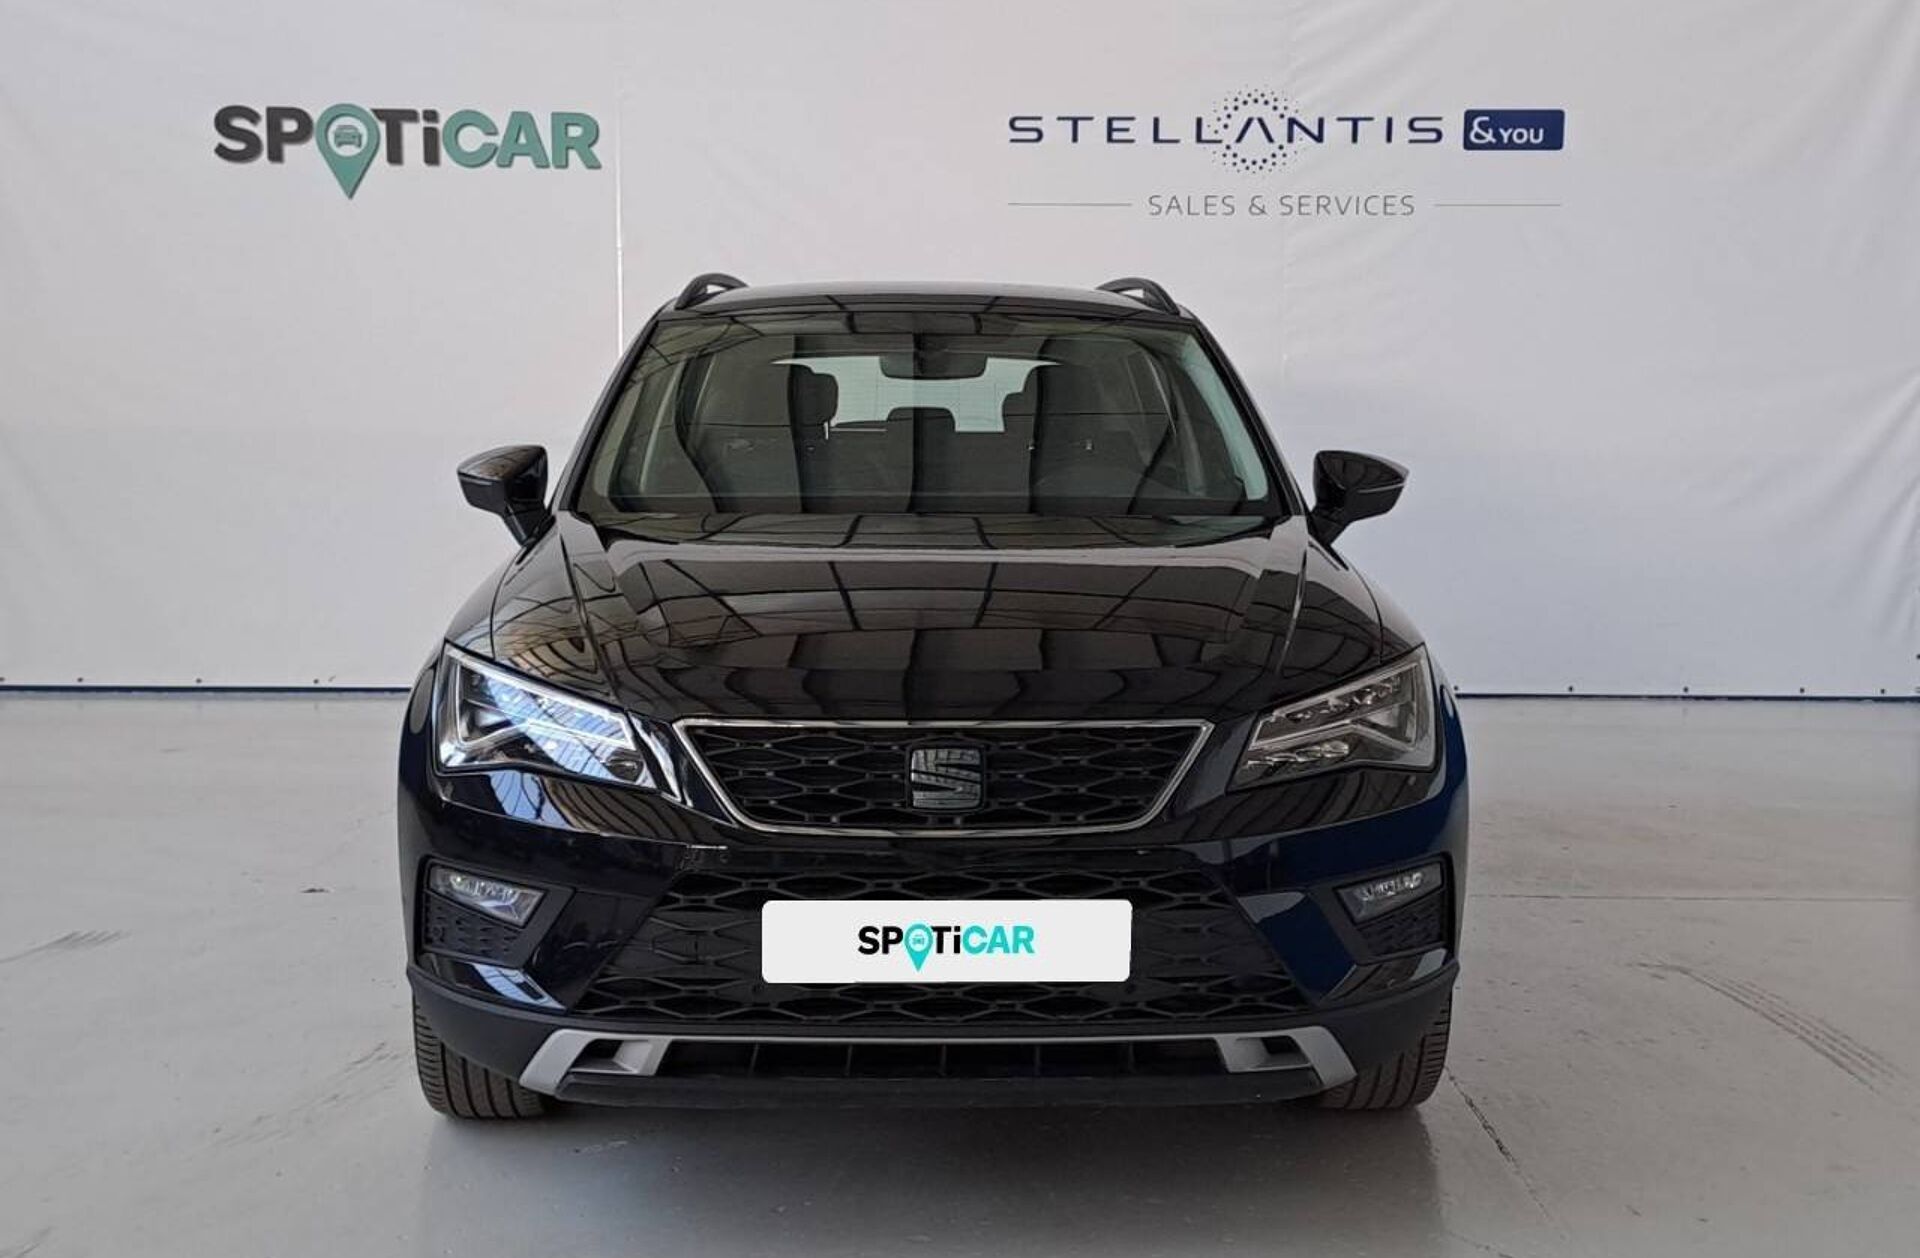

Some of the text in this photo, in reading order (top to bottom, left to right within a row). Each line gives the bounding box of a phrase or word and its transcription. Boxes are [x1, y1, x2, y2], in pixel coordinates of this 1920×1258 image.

[1008, 115, 1445, 144] STELLANTIS
[1147, 195, 1416, 217] SALES & SERVICES
